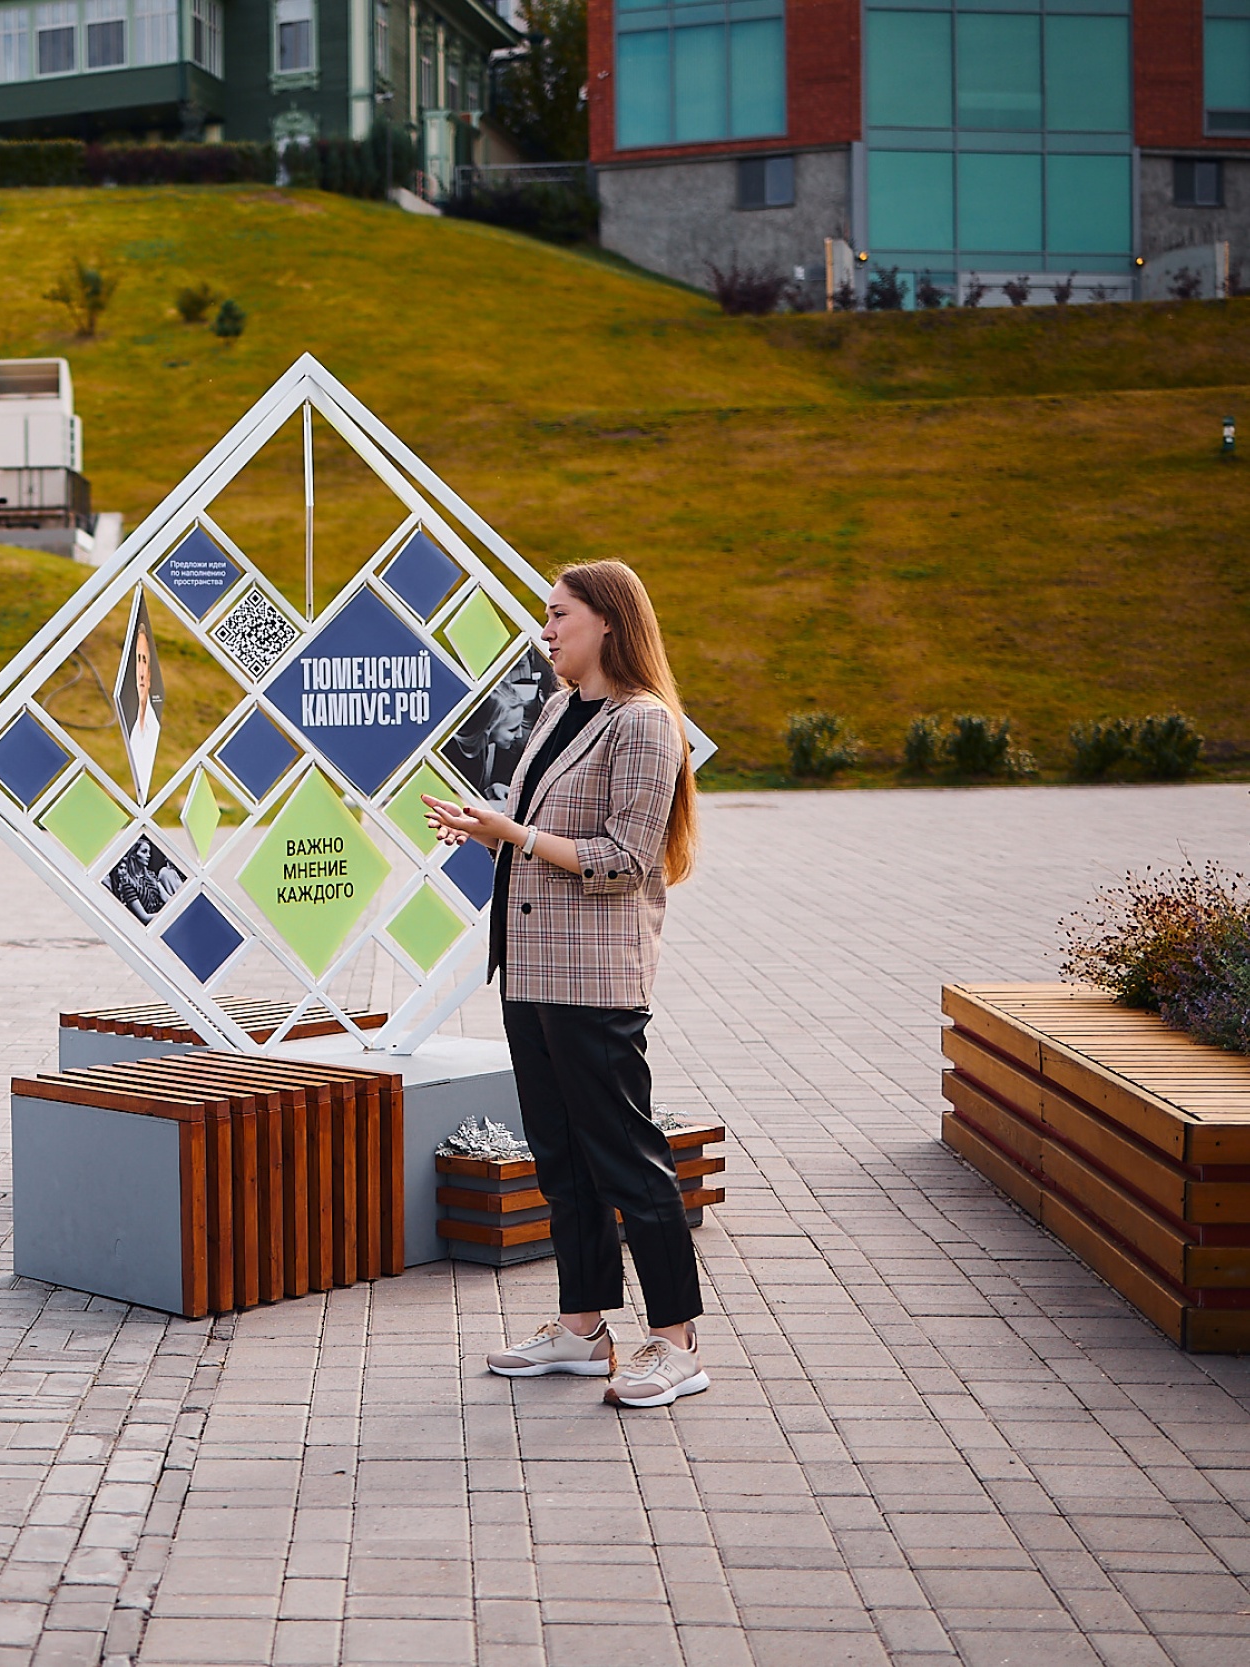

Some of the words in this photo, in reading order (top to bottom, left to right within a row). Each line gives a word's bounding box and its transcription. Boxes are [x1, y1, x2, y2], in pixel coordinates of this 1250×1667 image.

[170, 560, 207, 569] Предложи
[173, 579, 223, 587] пространства
[300, 650, 431, 690] ТЮМЕНСКИЙ
[302, 690, 430, 727] КАМПУС.РФ
[286, 837, 344, 857] ВАЖНО
[283, 860, 347, 880] МНЕНИЕ
[277, 882, 354, 905] КАЖДОГО
